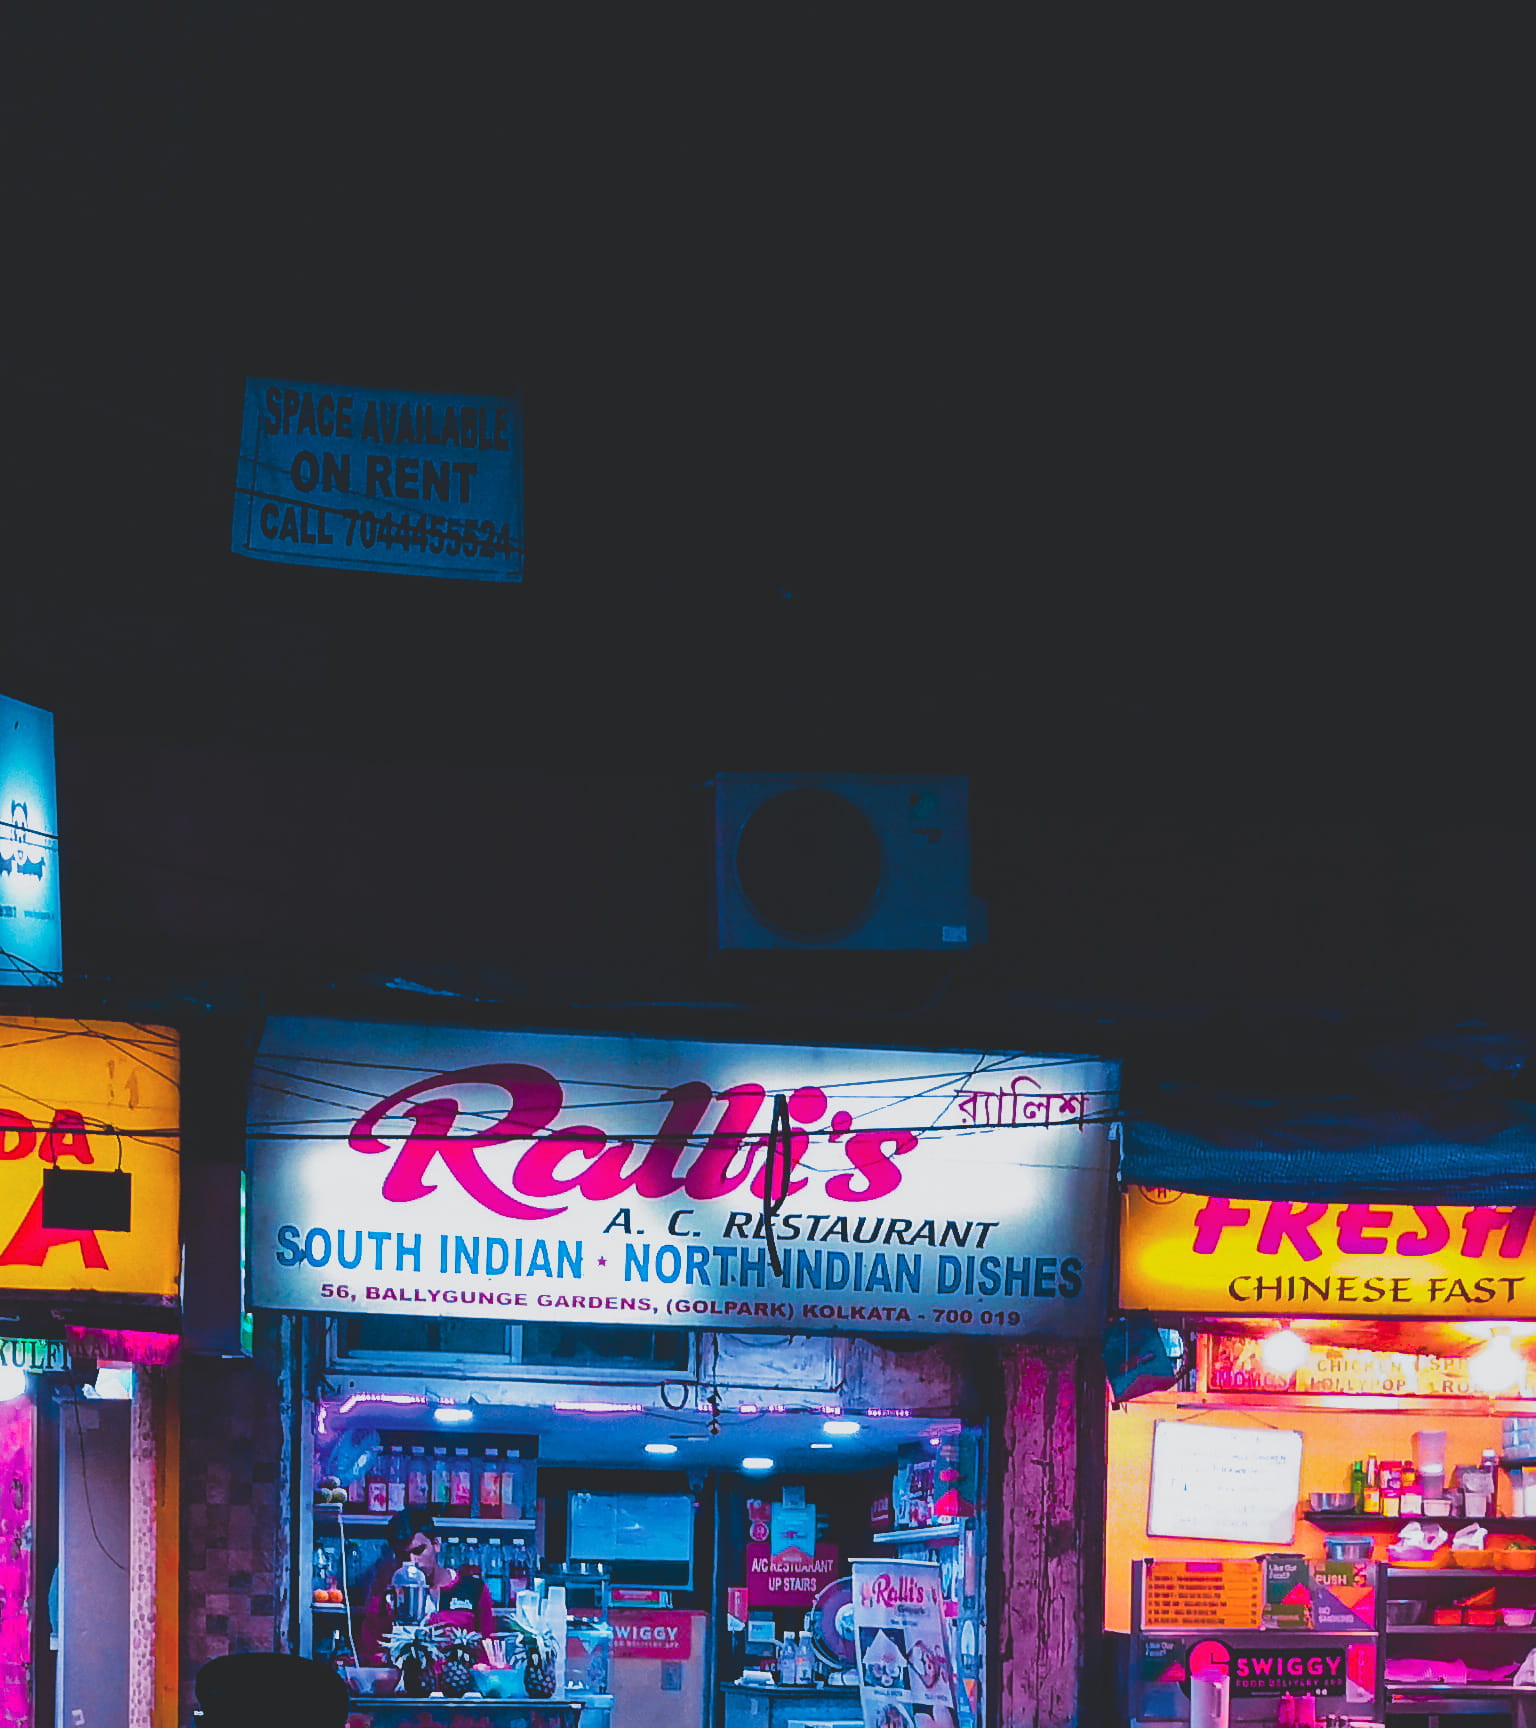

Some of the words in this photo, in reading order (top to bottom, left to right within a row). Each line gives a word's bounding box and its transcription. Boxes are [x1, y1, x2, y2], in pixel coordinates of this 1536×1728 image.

[264, 386, 353, 438] SPACE
[361, 401, 511, 451] AVAILABLE
[291, 451, 351, 494] ON
[367, 456, 478, 503] RENT
[260, 502, 333, 544] CALL
[348, 1062, 919, 1220] Ralli's
[603, 1207, 647, 1238] A.
[667, 1207, 702, 1238] C.
[723, 1210, 999, 1249] RESTAURANT
[276, 1225, 423, 1272] SOUTH
[438, 1234, 584, 1280] INDIAN
[623, 1244, 774, 1289] NORTH
[781, 1248, 921, 1296] INDIAN
[937, 1254, 1083, 1300] DISHES
[319, 1282, 357, 1305] 56,
[364, 1285, 529, 1309] BALLYGUNGE
[536, 1293, 659, 1316] GARDENS,
[665, 1297, 795, 1322] (GOLPARK)
[802, 1303, 909, 1324] KOLKATA
[931, 1307, 973, 1327] 700
[978, 1309, 1022, 1328] 019
[1228, 1275, 1413, 1303] CHINESE
[1427, 1276, 1525, 1303] FAST
[768, 1577, 782, 1591] UP
[784, 1578, 816, 1591] STAIRS
[873, 1573, 924, 1608] Ralli's
[1236, 1657, 1342, 1677] SWIGGY
